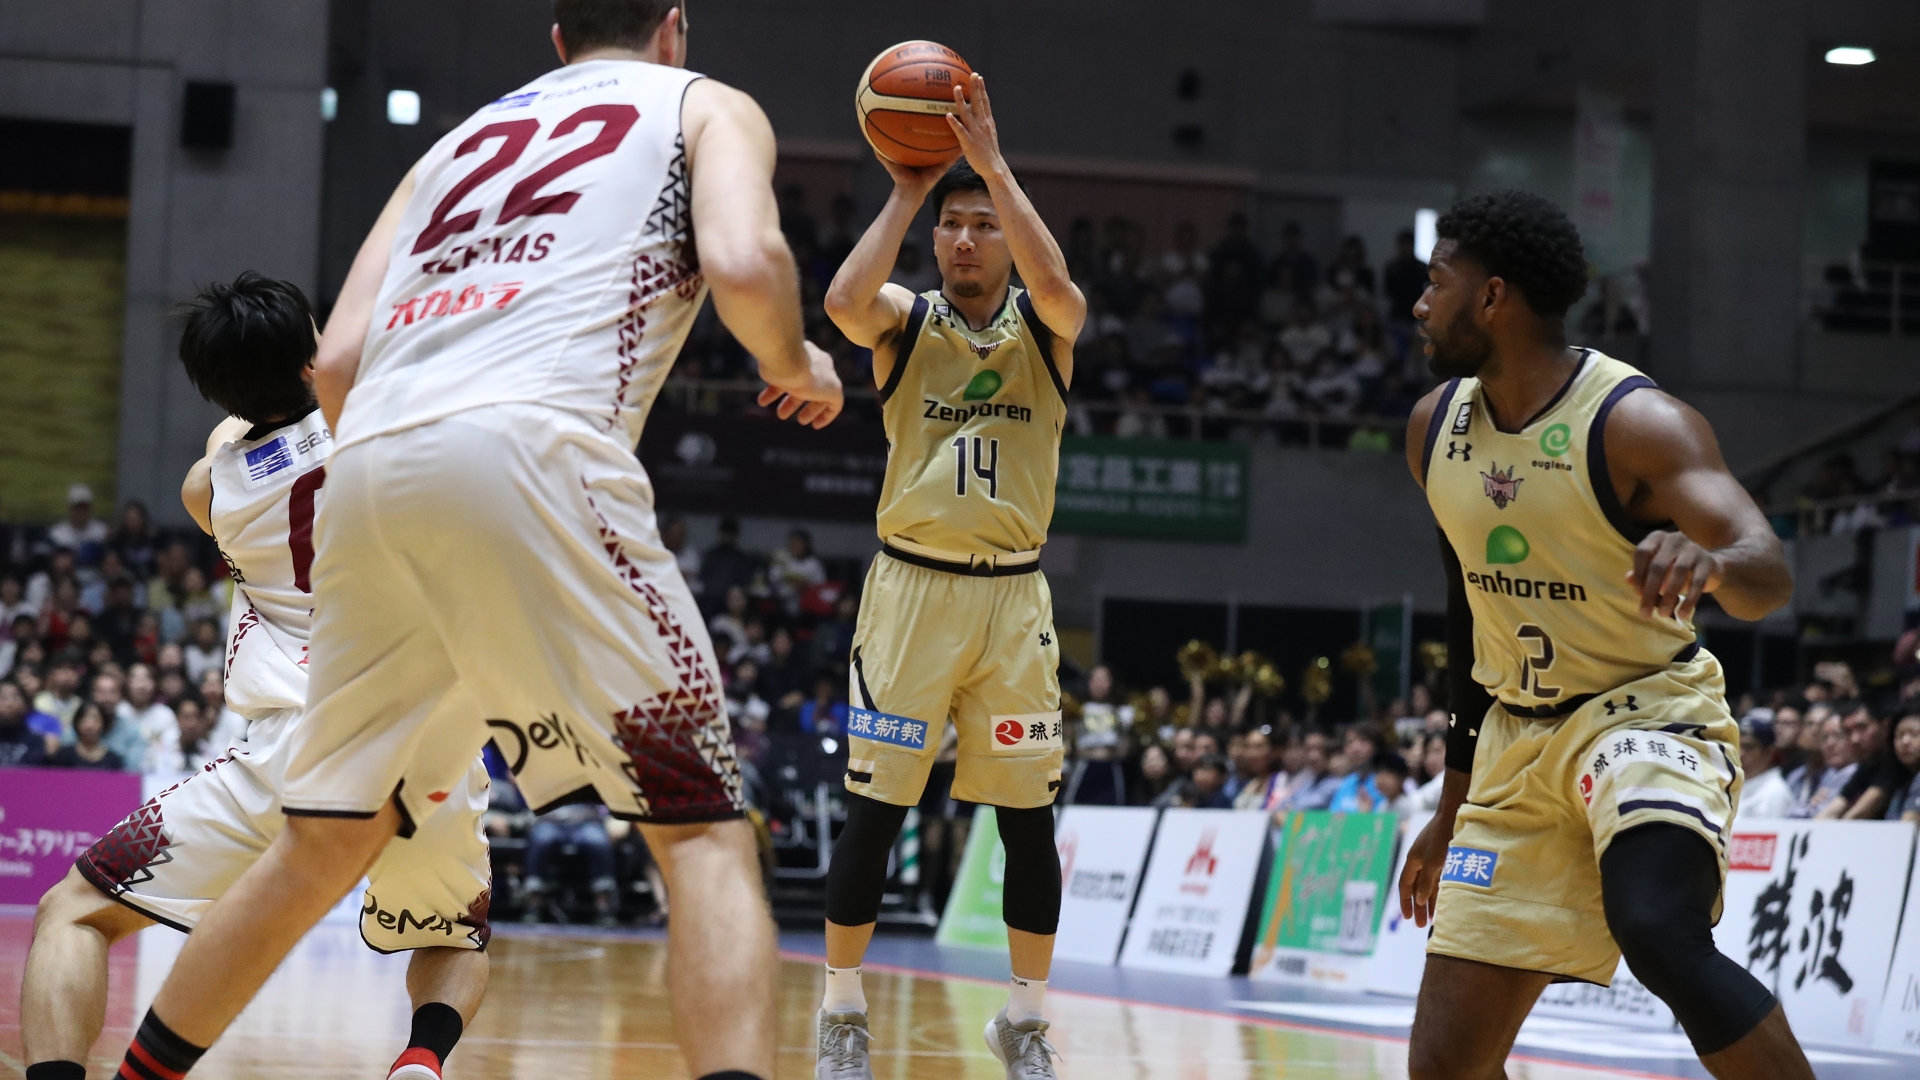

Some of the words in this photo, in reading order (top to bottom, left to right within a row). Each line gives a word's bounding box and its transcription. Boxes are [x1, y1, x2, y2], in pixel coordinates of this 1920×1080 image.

[925, 69, 951, 82] FIBA
[409, 104, 641, 257] 22
[951, 436, 999, 500] 14
[1531, 460, 1573, 472] euglena
[1466, 569, 1587, 602] enhoren
[1592, 737, 1699, 780] 琉球銀行
